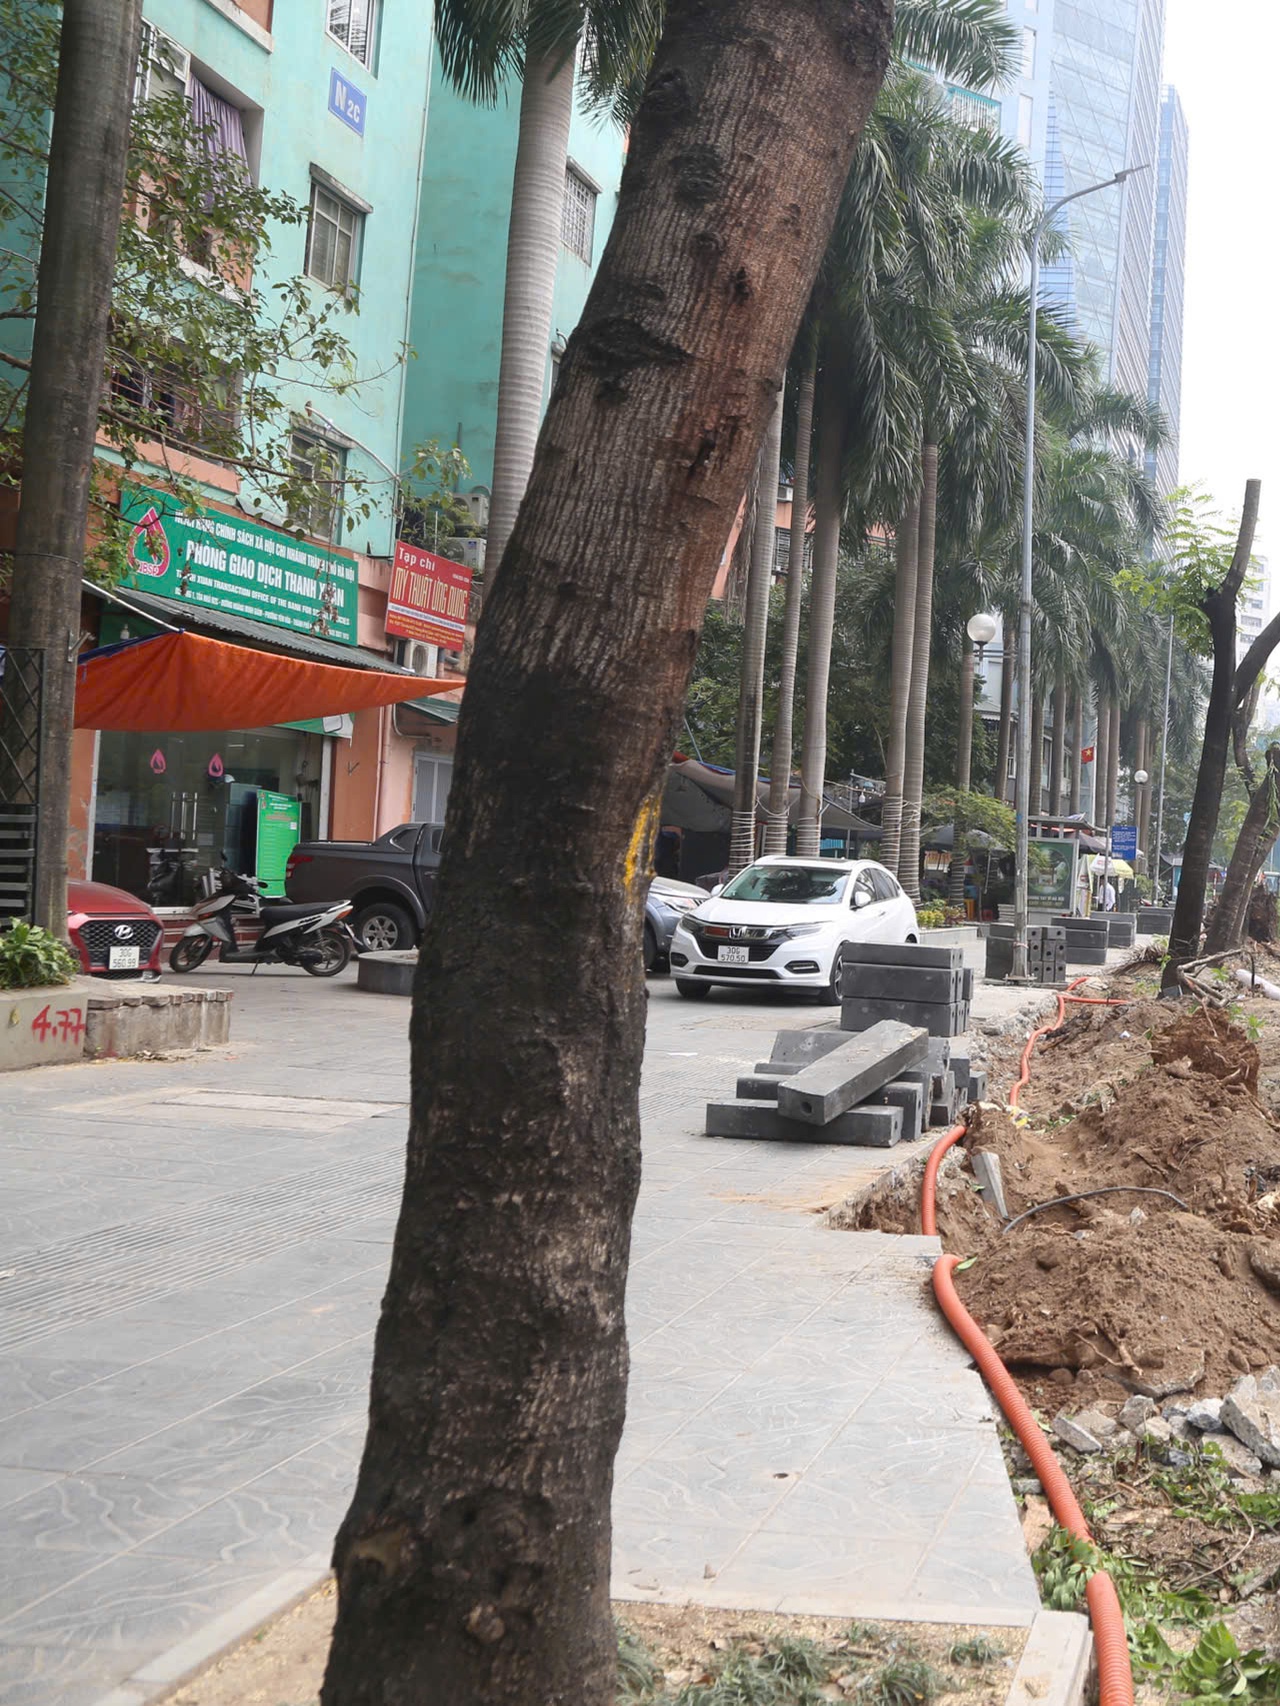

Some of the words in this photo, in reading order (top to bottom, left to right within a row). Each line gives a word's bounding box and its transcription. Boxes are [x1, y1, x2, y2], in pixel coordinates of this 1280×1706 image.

[335, 80, 347, 111] N
[347, 100, 360, 123] 2C
[215, 522, 237, 541] CHÍNH
[237, 529, 255, 547] SÁCH
[134, 560, 160, 576] BSP
[186, 540, 227, 572] PHÒNG
[229, 553, 256, 580] GIAO
[257, 561, 283, 589] DỊCH
[284, 571, 317, 599] THANH
[318, 581, 345, 608] XÂN
[31, 1004, 85, 1044] 4.77
